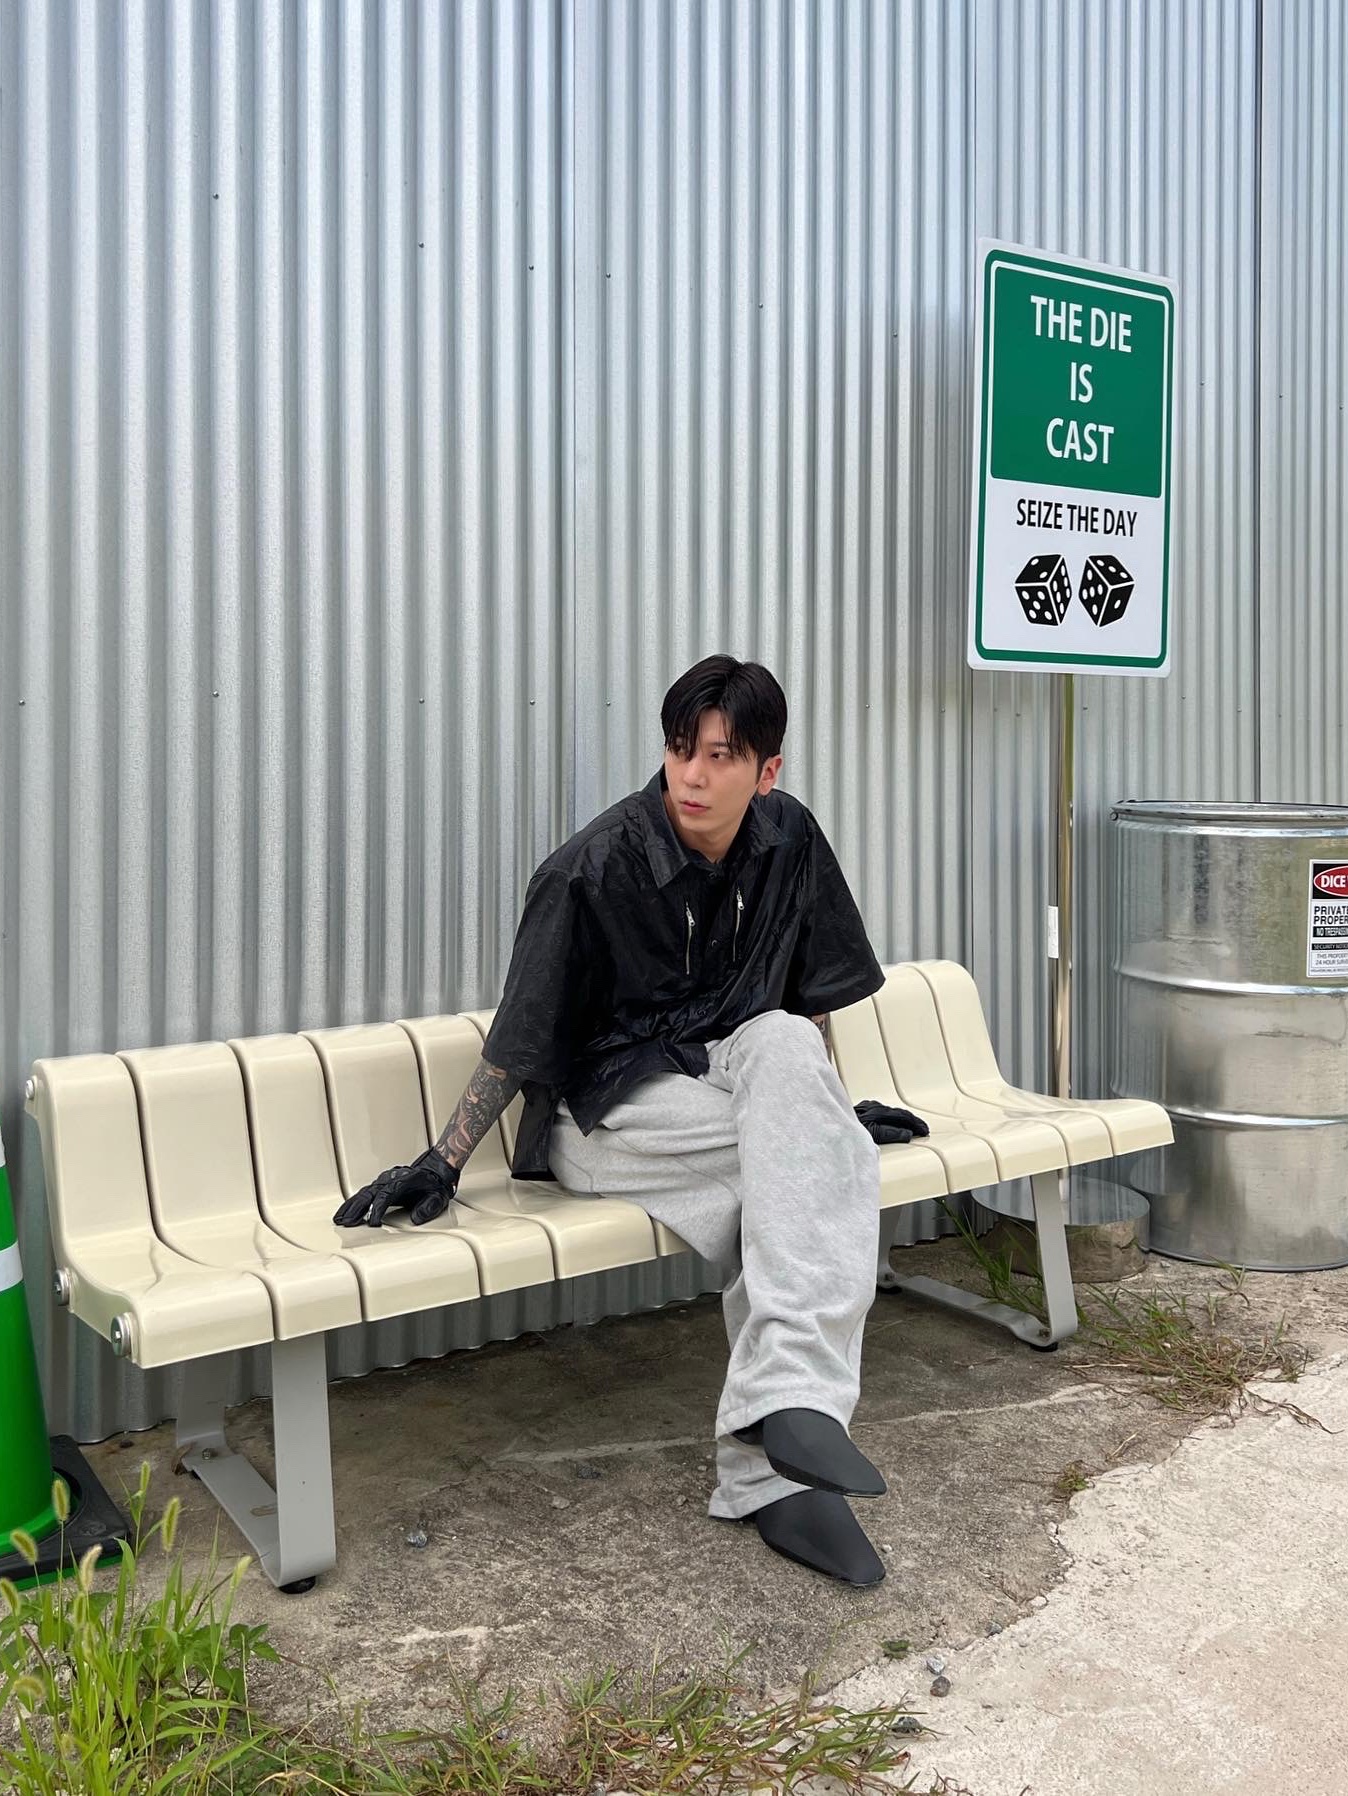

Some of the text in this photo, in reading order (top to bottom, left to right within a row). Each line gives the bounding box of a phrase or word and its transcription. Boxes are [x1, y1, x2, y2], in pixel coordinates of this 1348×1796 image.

[1030, 295, 1132, 353] THE DIE
[1070, 361, 1093, 403] IS
[1046, 417, 1115, 464] CAST
[1016, 498, 1138, 538] SEIZE THE DAY
[1320, 875, 1346, 888] DICE
